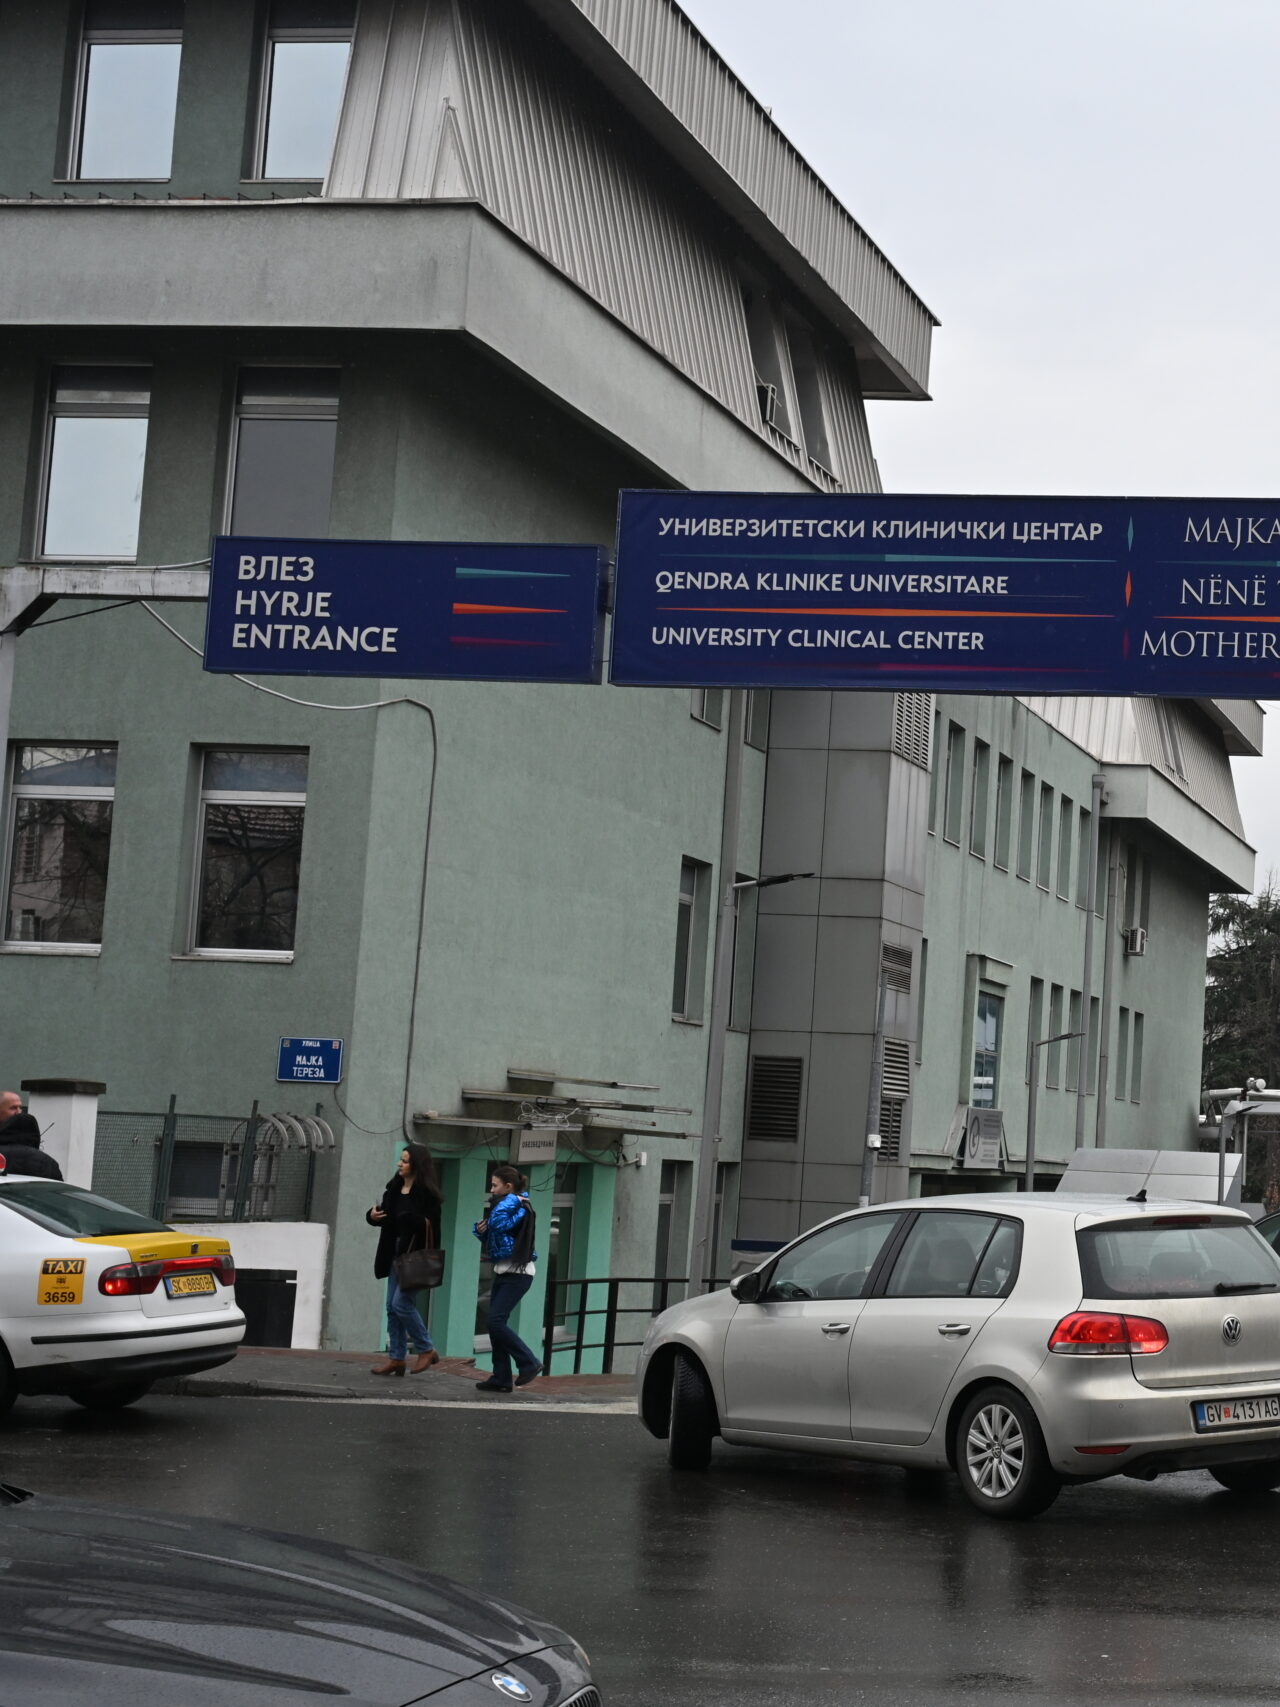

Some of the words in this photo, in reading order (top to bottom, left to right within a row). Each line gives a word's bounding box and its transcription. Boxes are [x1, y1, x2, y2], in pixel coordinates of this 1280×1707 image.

[658, 517, 865, 538] УНИВЕРЗИТЕТСКИ
[872, 520, 1005, 540] КЛИНИЧКИ
[1012, 522, 1103, 544] ЦЕНТАР
[238, 555, 314, 582] ВЛЕЗ
[655, 571, 750, 593] QENDRA
[756, 572, 843, 592] KLINIKE
[850, 574, 1009, 594] UNIVERSITARE
[1181, 574, 1266, 606] NËNË
[235, 590, 332, 617] HYRJE
[232, 623, 399, 653] ENTRANCE
[652, 626, 782, 647] UNIVERSITY
[787, 628, 891, 649] CLINICAL
[898, 630, 984, 650] CENTER
[292, 1067, 325, 1078] ТЕРЕЗА
[295, 1055, 323, 1066] МАЈКА
[46, 1260, 82, 1273] TAXI
[43, 1291, 75, 1303] 3659
[1206, 1404, 1222, 1423] GV
[1232, 1401, 1262, 1420] 4131
[1264, 1399, 1280, 1418] AG
